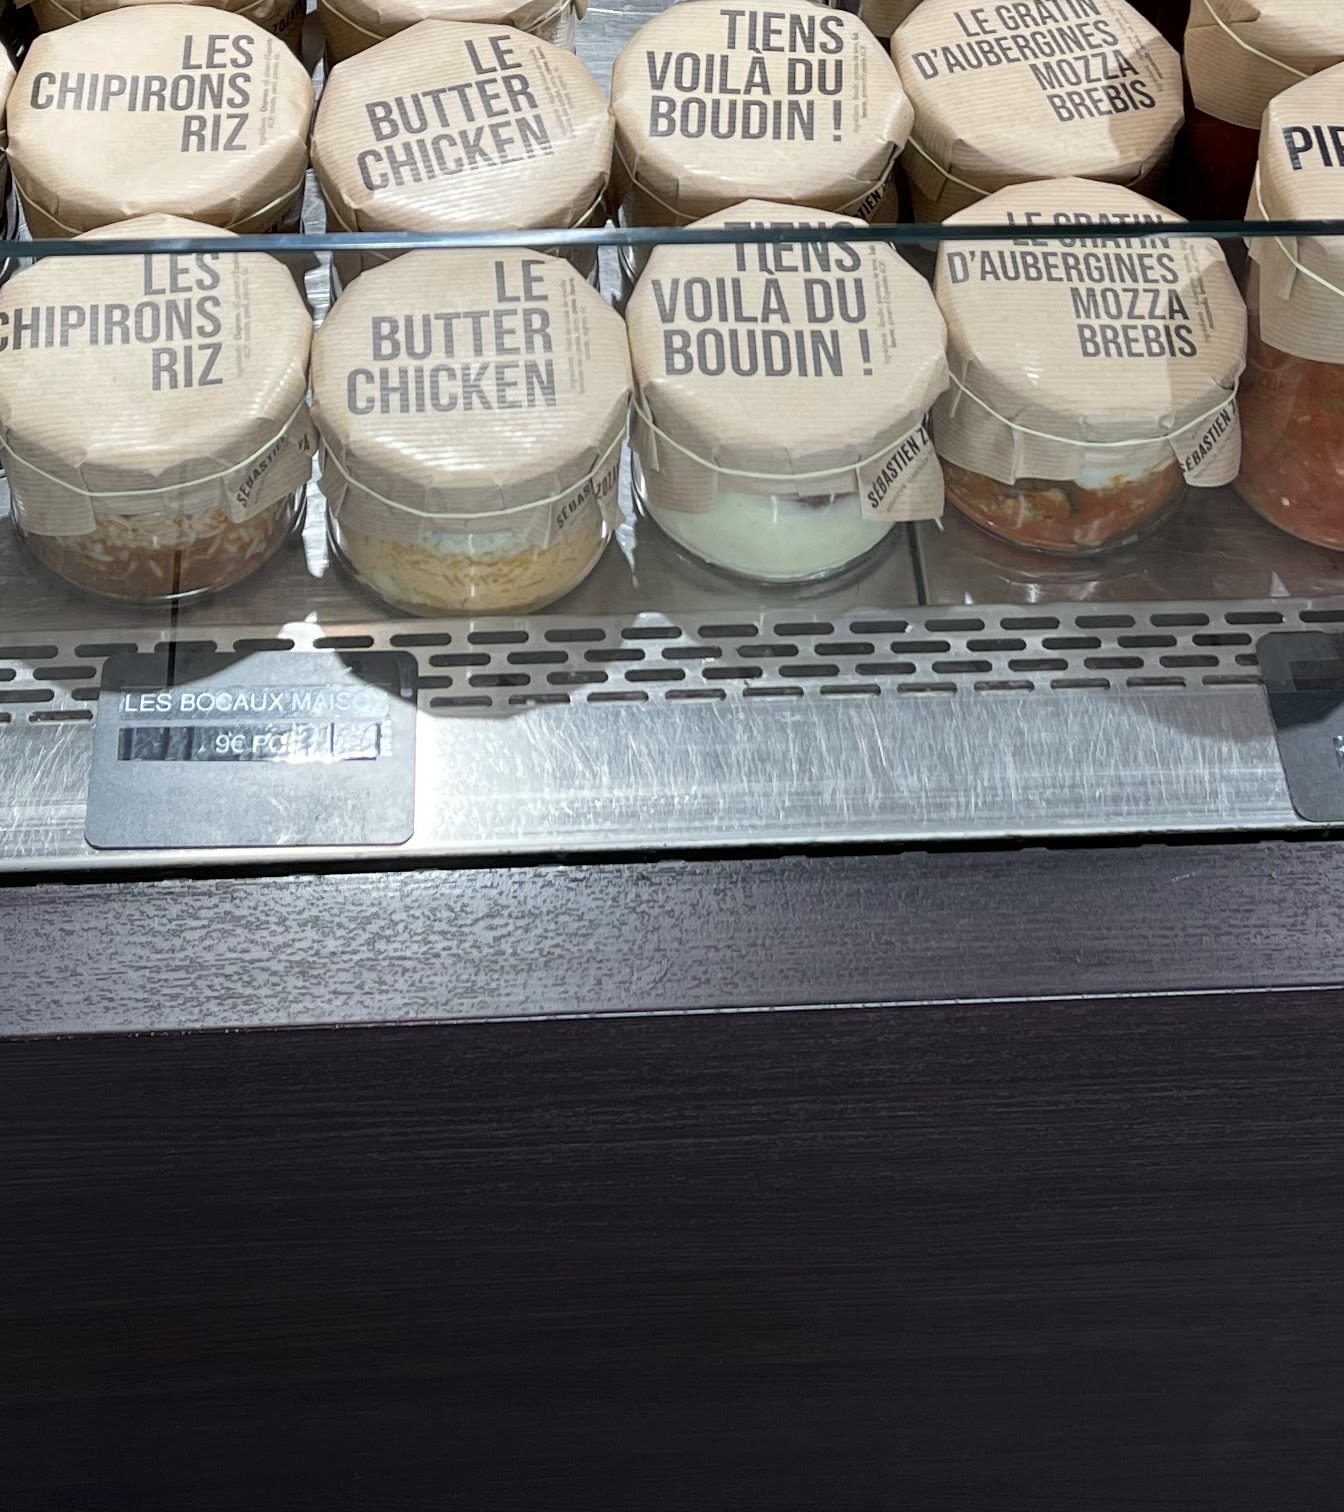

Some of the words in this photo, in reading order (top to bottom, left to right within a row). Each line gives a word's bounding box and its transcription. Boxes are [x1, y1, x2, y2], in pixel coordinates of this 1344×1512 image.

[720, 9, 844, 54] TIENS
[954, 8, 996, 37] LE
[182, 35, 254, 69] LES
[647, 49, 771, 96] VOILÀ
[787, 58, 843, 96] DU
[1029, 50, 1139, 90] MOZZA
[30, 72, 251, 111] CHIPIRONS
[1046, 80, 1156, 122] BREBIS
[181, 113, 249, 152] RIZ
[649, 96, 814, 141] BOUDIN
[495, 260, 548, 303] LE
[372, 308, 553, 361] BUTTER
[347, 359, 557, 415] CHICKEN
[124, 694, 172, 712] LES
[180, 693, 284, 711] BOCAUX
